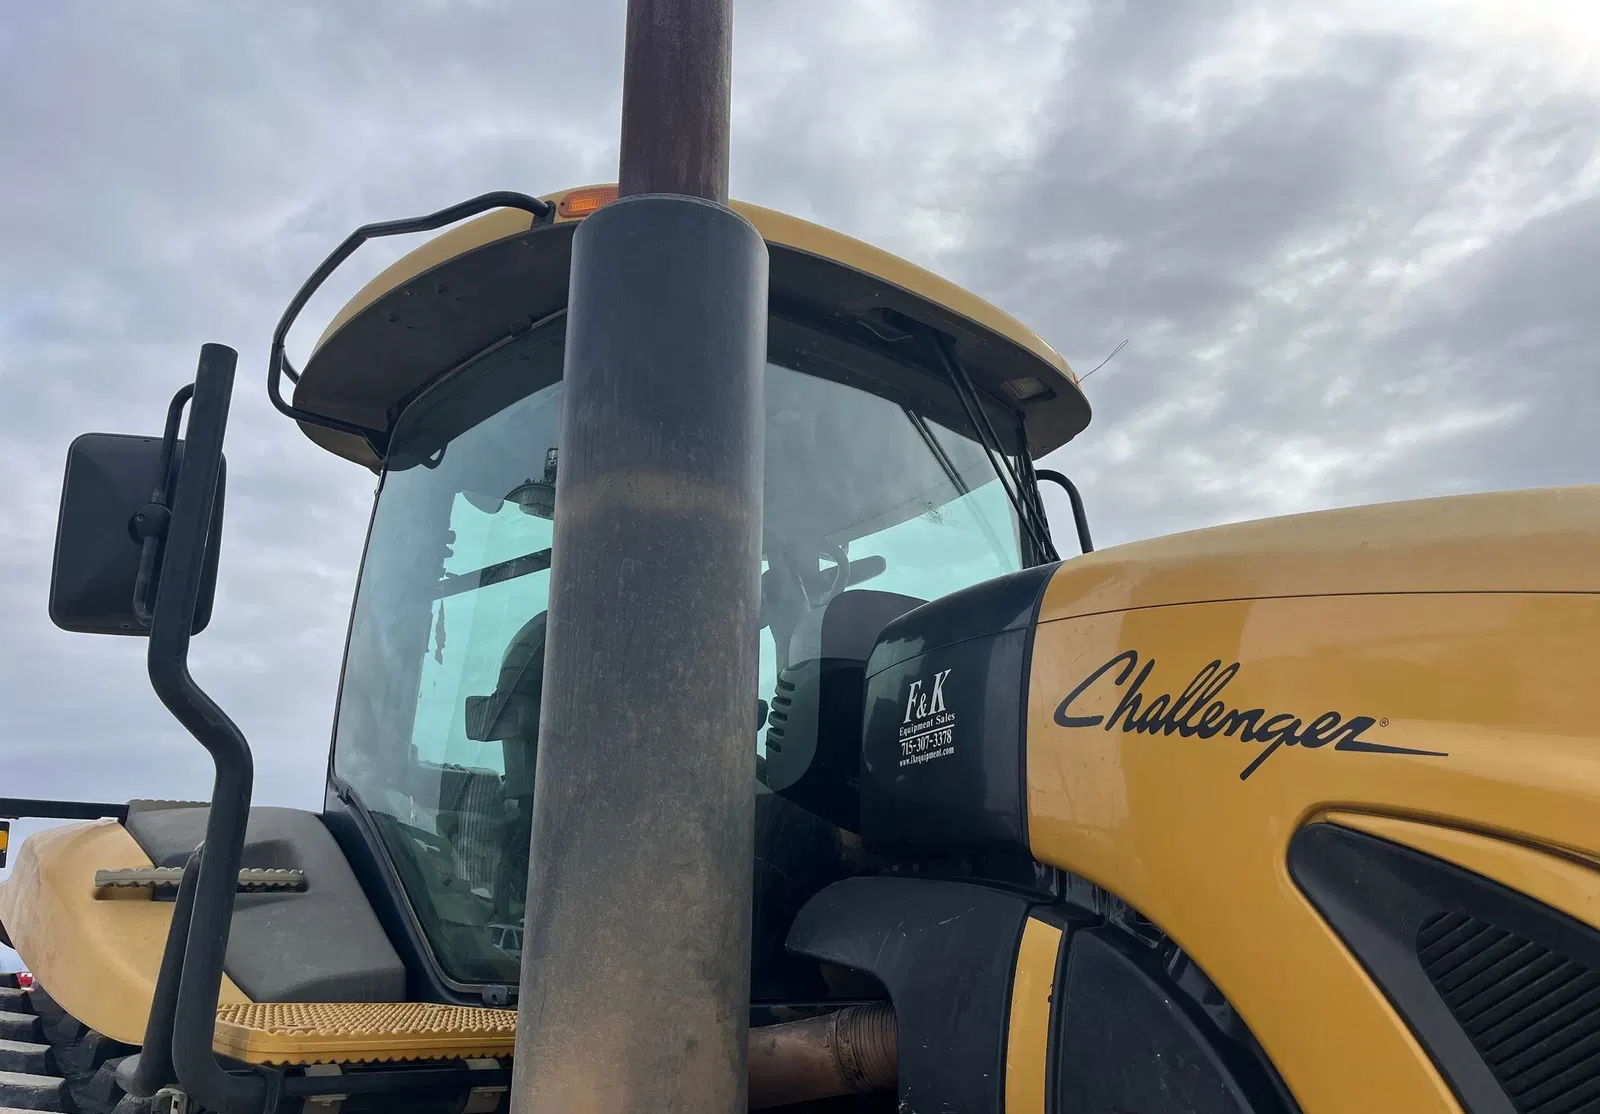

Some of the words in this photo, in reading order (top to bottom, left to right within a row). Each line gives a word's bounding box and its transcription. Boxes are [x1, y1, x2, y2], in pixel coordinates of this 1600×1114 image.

[899, 719, 934, 737] Equipment
[935, 713, 956, 725] Sales
[901, 728, 952, 756] 715-307-3378
